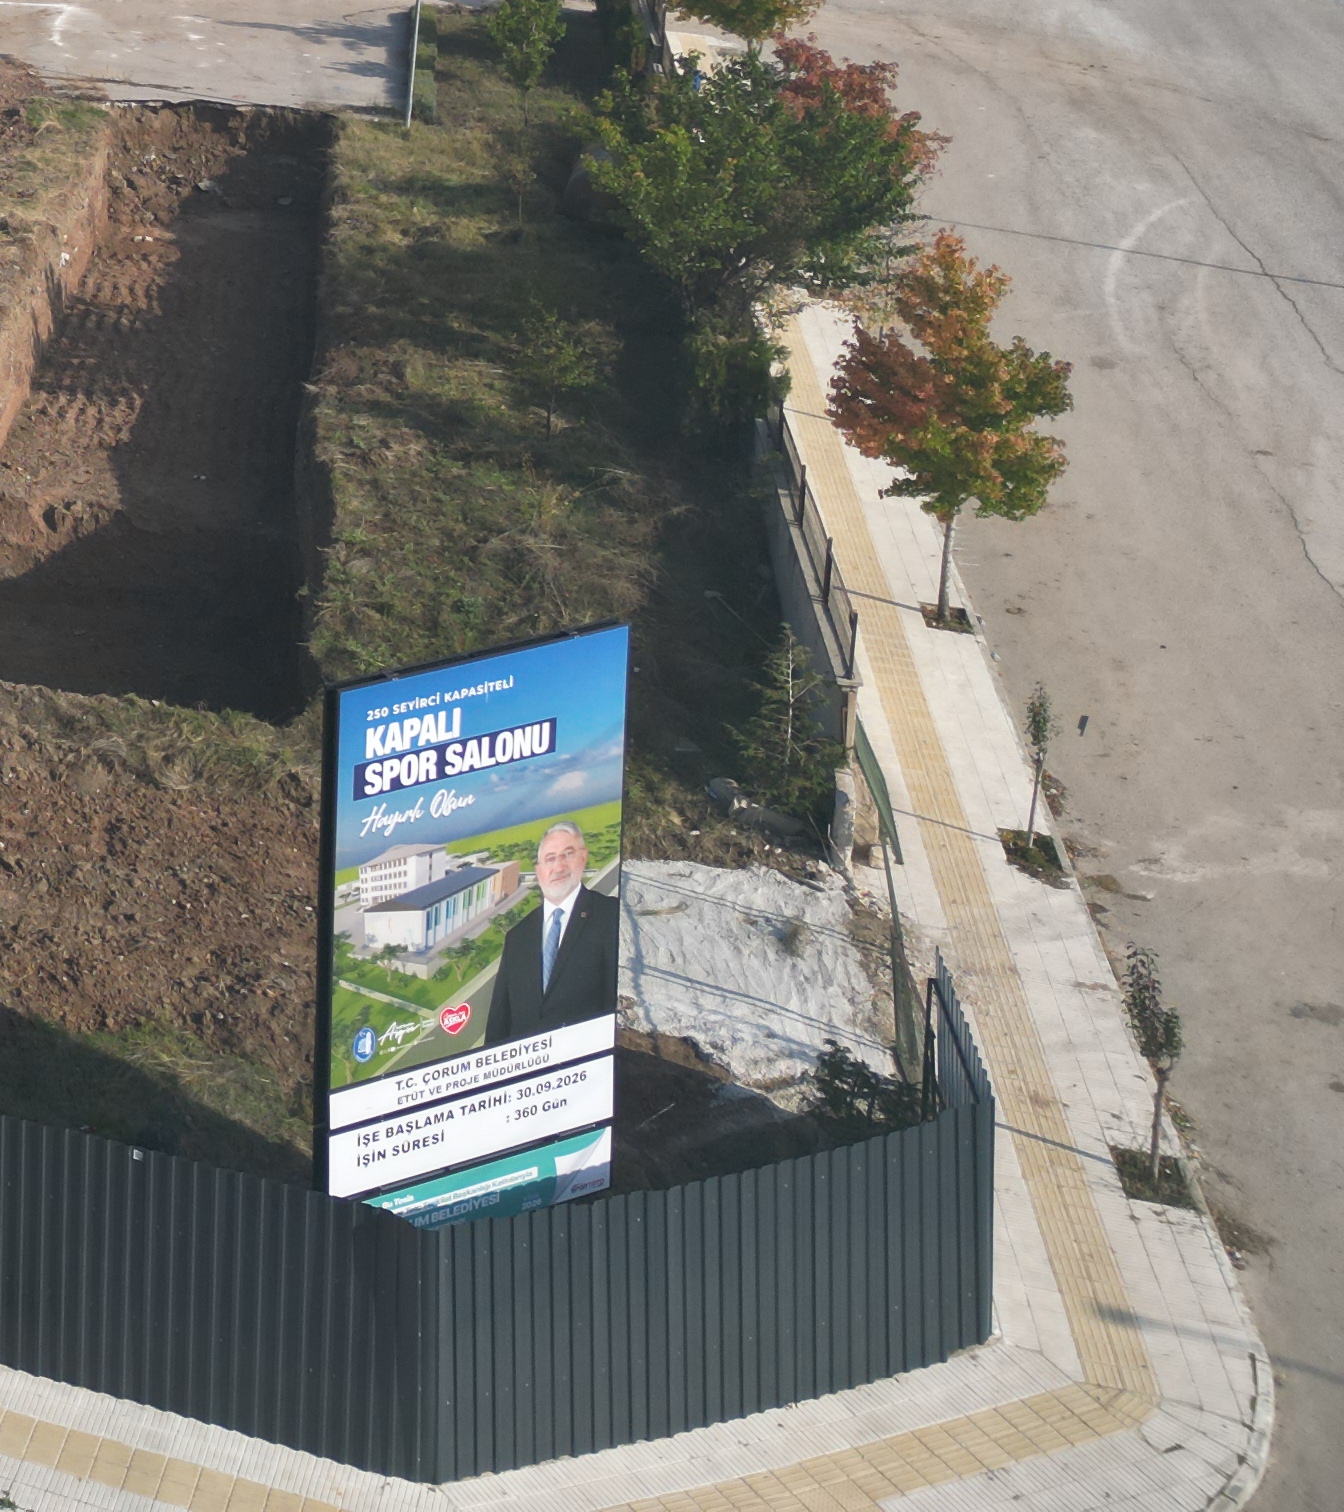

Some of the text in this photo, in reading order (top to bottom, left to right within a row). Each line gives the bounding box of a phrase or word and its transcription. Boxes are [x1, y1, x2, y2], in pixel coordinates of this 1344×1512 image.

[366, 675, 514, 721] 250 SEYİRCİ KAPASİTELİ
[363, 721, 550, 796] SPOR SALONU
[365, 707, 461, 759] KAPALI
[429, 788, 476, 819] Olsun
[395, 1035, 552, 1091] T.C. ÇORUM BELEDİYESİ
[397, 1053, 550, 1105] ETÜT VE PROJE MÜDÜRLÜĞÜ
[356, 1149, 387, 1168] İŞİN
[392, 1129, 445, 1157] SÜRESİ
[514, 1104, 538, 1122] 360
[541, 1097, 568, 1112] Gün
[357, 1070, 587, 1148] İŞE BAŞLAMA TARİHİ: 30.09.2026
[431, 1191, 500, 1224] BELEDİYESİ
